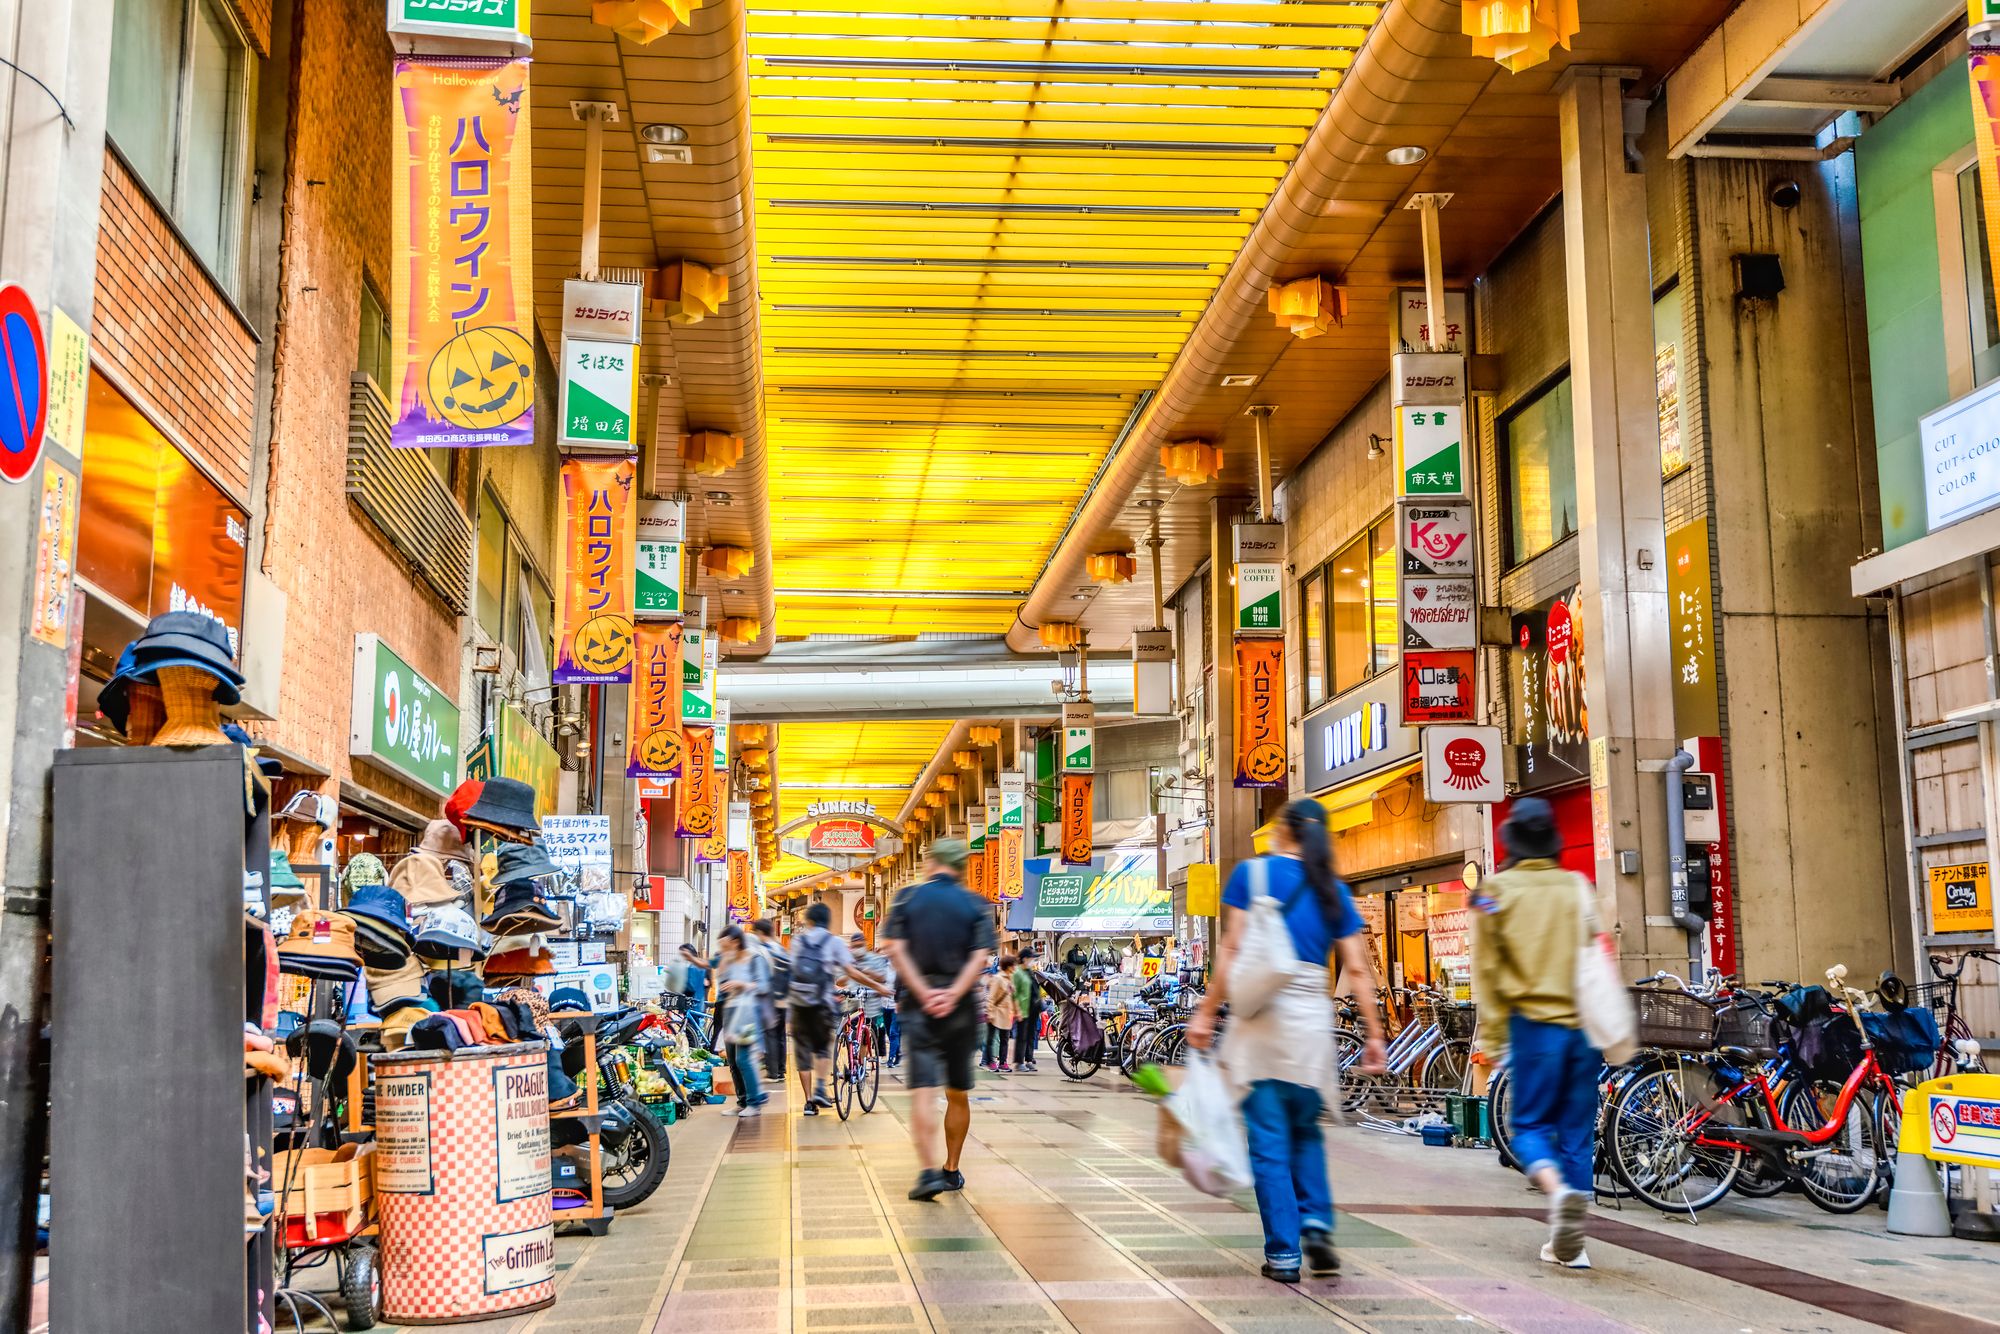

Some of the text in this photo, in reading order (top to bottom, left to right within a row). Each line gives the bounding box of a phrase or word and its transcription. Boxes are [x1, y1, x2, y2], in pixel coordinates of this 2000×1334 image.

[449, 116, 492, 322] ハロウィン
[574, 306, 632, 322] サンライズ
[577, 353, 625, 372] そば処
[1405, 376, 1456, 387] サンライズ
[572, 416, 625, 435] 増田屋
[1935, 434, 1956, 452] CUT
[1411, 471, 1455, 486] 南天堂
[1938, 471, 1977, 496] COLOR
[639, 517, 679, 527] サンライズ
[588, 489, 613, 611] ハロウィン
[644, 597, 668, 607] ユウ
[1407, 634, 1422, 646] 2F
[1407, 666, 1470, 686] 入口は裏へ
[649, 644, 667, 728] ハロウィン
[1254, 660, 1271, 740] ハロウィン
[1410, 695, 1470, 709] お廻り下さい
[1324, 701, 1388, 771] DOUTOR
[1448, 750, 1481, 761] たこ焼
[807, 801, 877, 817] SUNRISE
[543, 832, 608, 845] 洗えるマスク
[1933, 865, 1987, 881] テナント募集中
[1144, 961, 1158, 975] 29
[387, 1083, 425, 1097] POWDER
[505, 1071, 545, 1099] PRAGUE
[488, 1255, 506, 1271] The
[506, 1240, 546, 1270] Griffith
